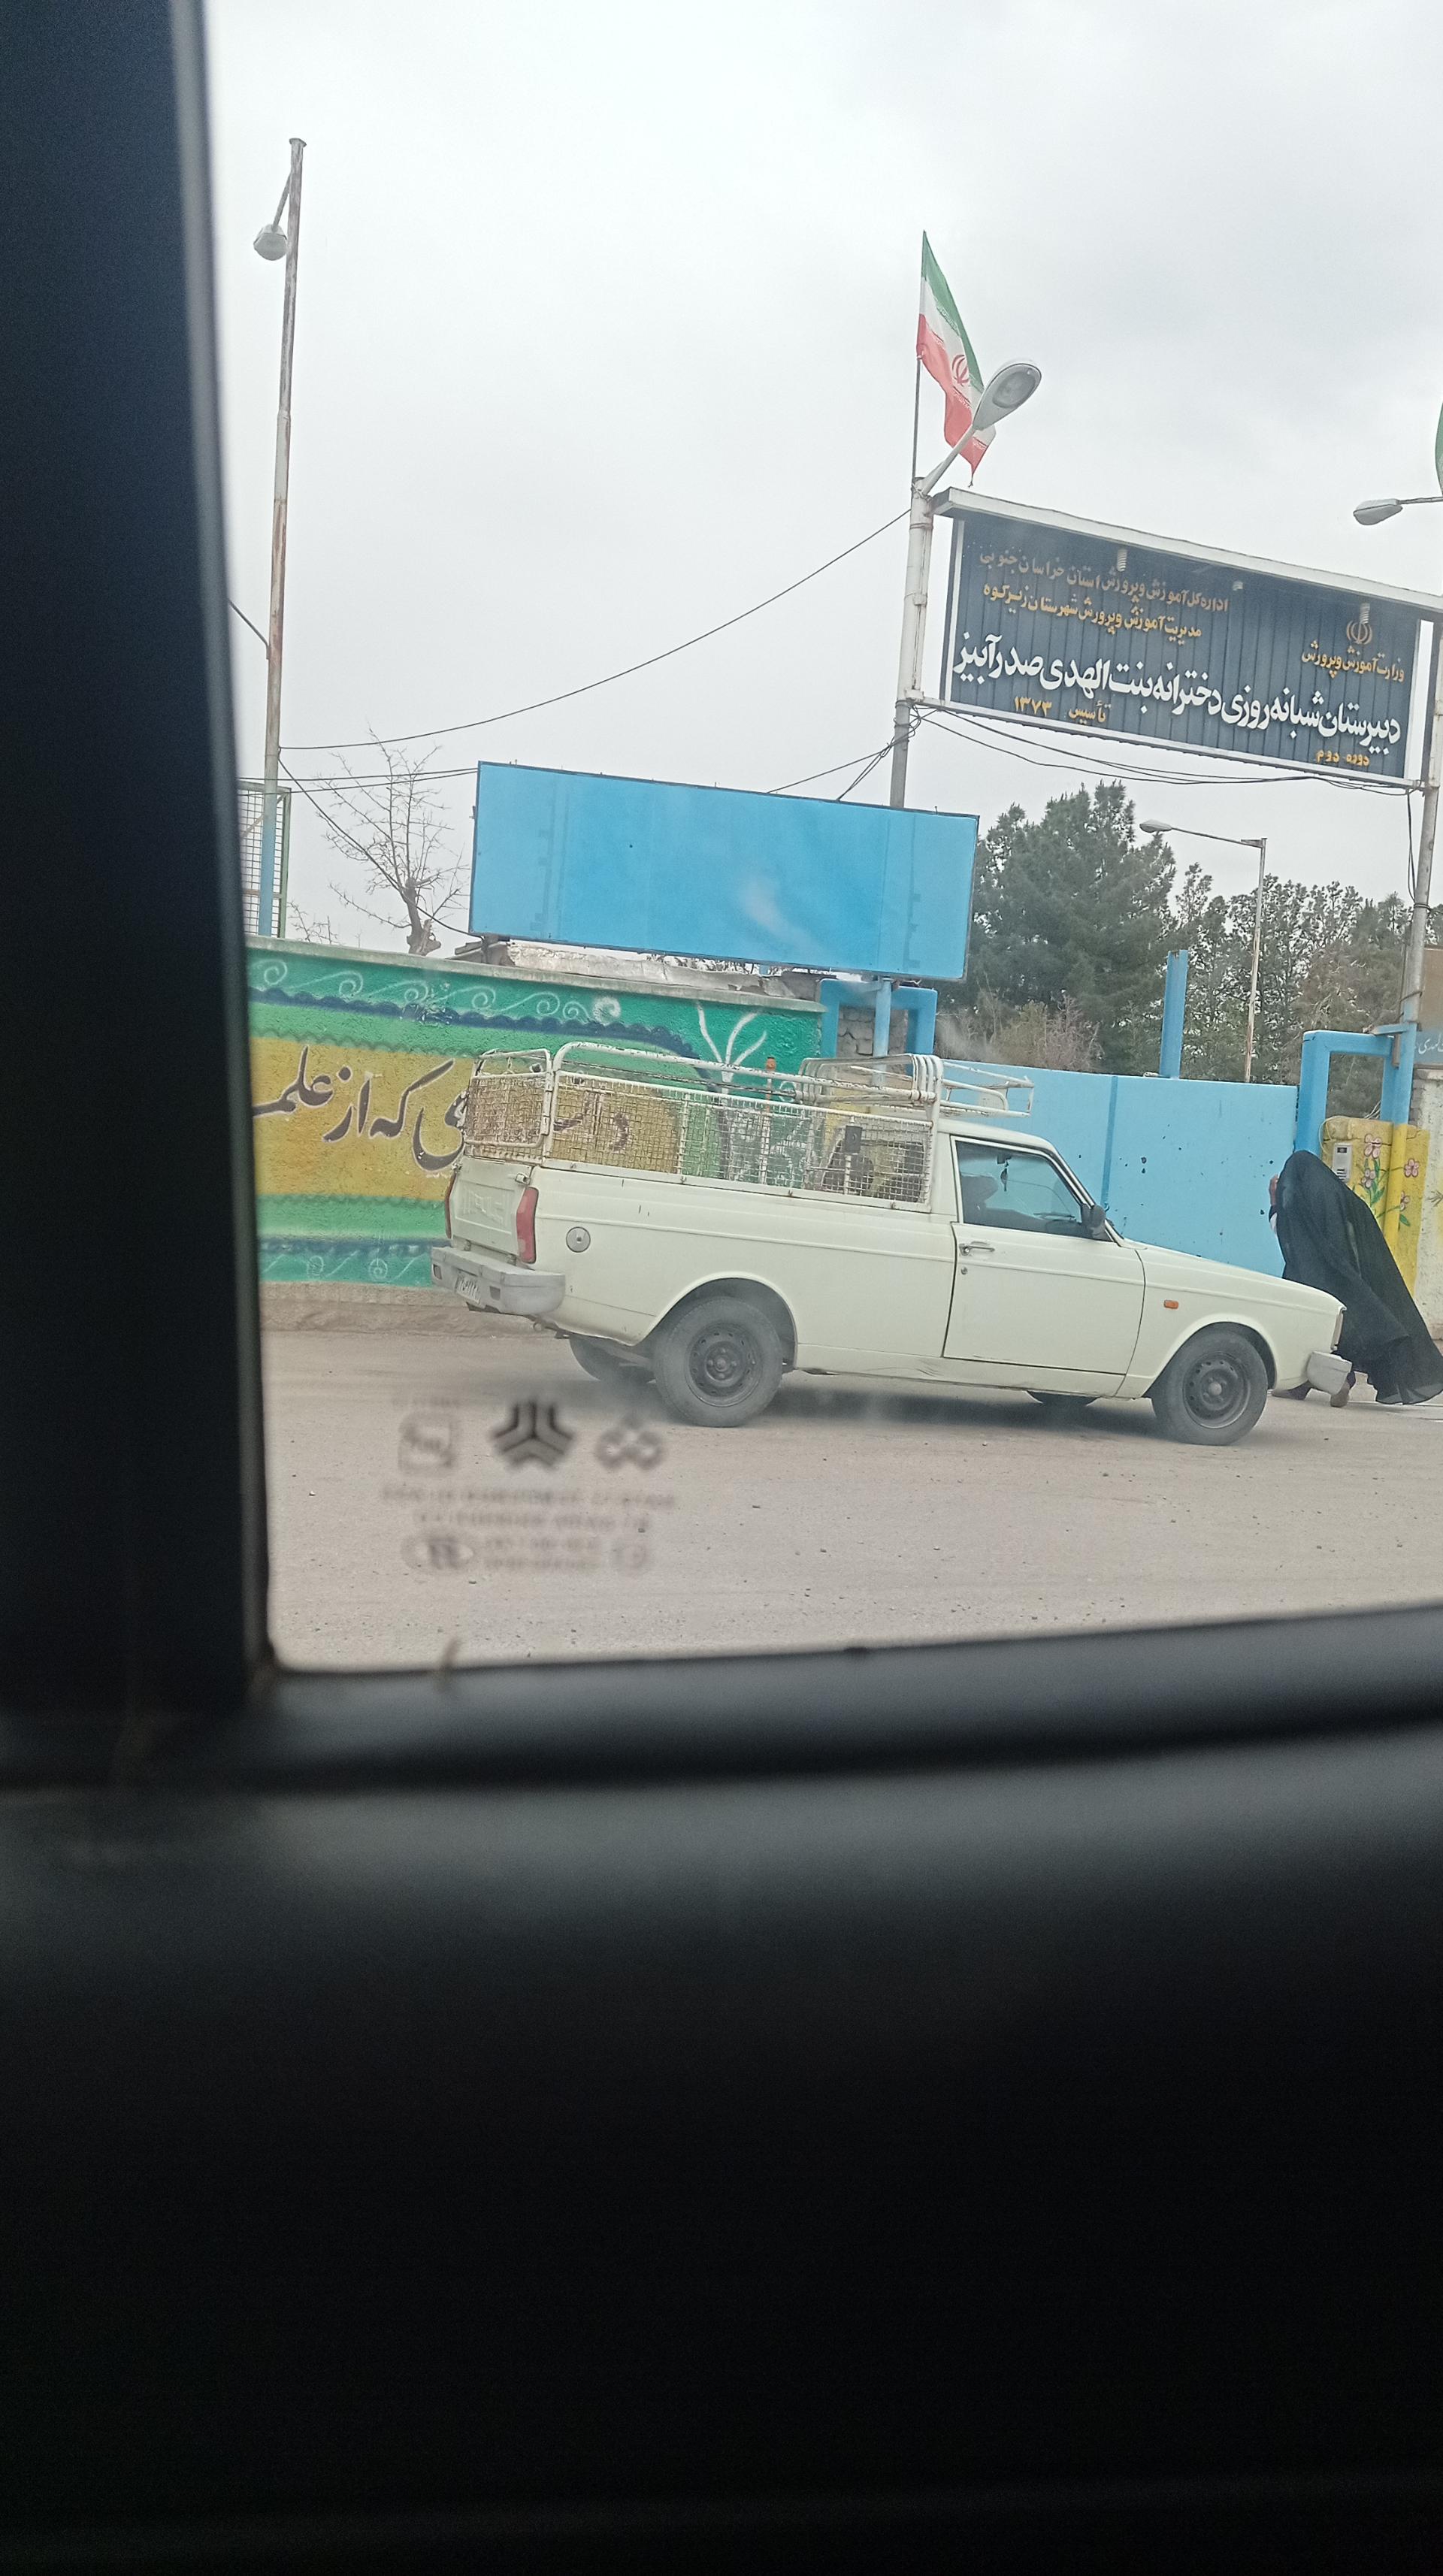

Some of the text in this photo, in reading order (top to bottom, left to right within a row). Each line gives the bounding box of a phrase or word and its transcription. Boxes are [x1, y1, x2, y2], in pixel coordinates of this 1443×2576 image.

[979, 551, 1018, 574] جنوبی
[1018, 555, 1064, 579] خراسان
[1066, 565, 1101, 589] استان
[983, 583, 1027, 614] زیرکوه
[1027, 594, 1078, 617] شهرستان
[1146, 578, 1189, 604] آموزش
[1187, 591, 1202, 607] کل
[1201, 597, 1228, 612] اداره
[1124, 606, 1166, 632] آموزش
[1165, 616, 1202, 646] مدیریت
[952, 631, 1003, 685] آبیز
[988, 647, 1044, 679] صدر
[1342, 646, 1378, 674] آموزش
[1376, 652, 1405, 682] وزارت
[1039, 658, 1111, 700] الهدی
[1108, 661, 1154, 714] بنت
[1152, 661, 1222, 715] دخترانه
[1015, 696, 1052, 718] ۱۳۷۳
[1317, 702, 1402, 755] دبیرستان
[1316, 749, 1370, 766] دوره دوم
[253, 1044, 334, 1119] علم
[322, 1065, 371, 1144] از
[369, 1057, 455, 1140] که
